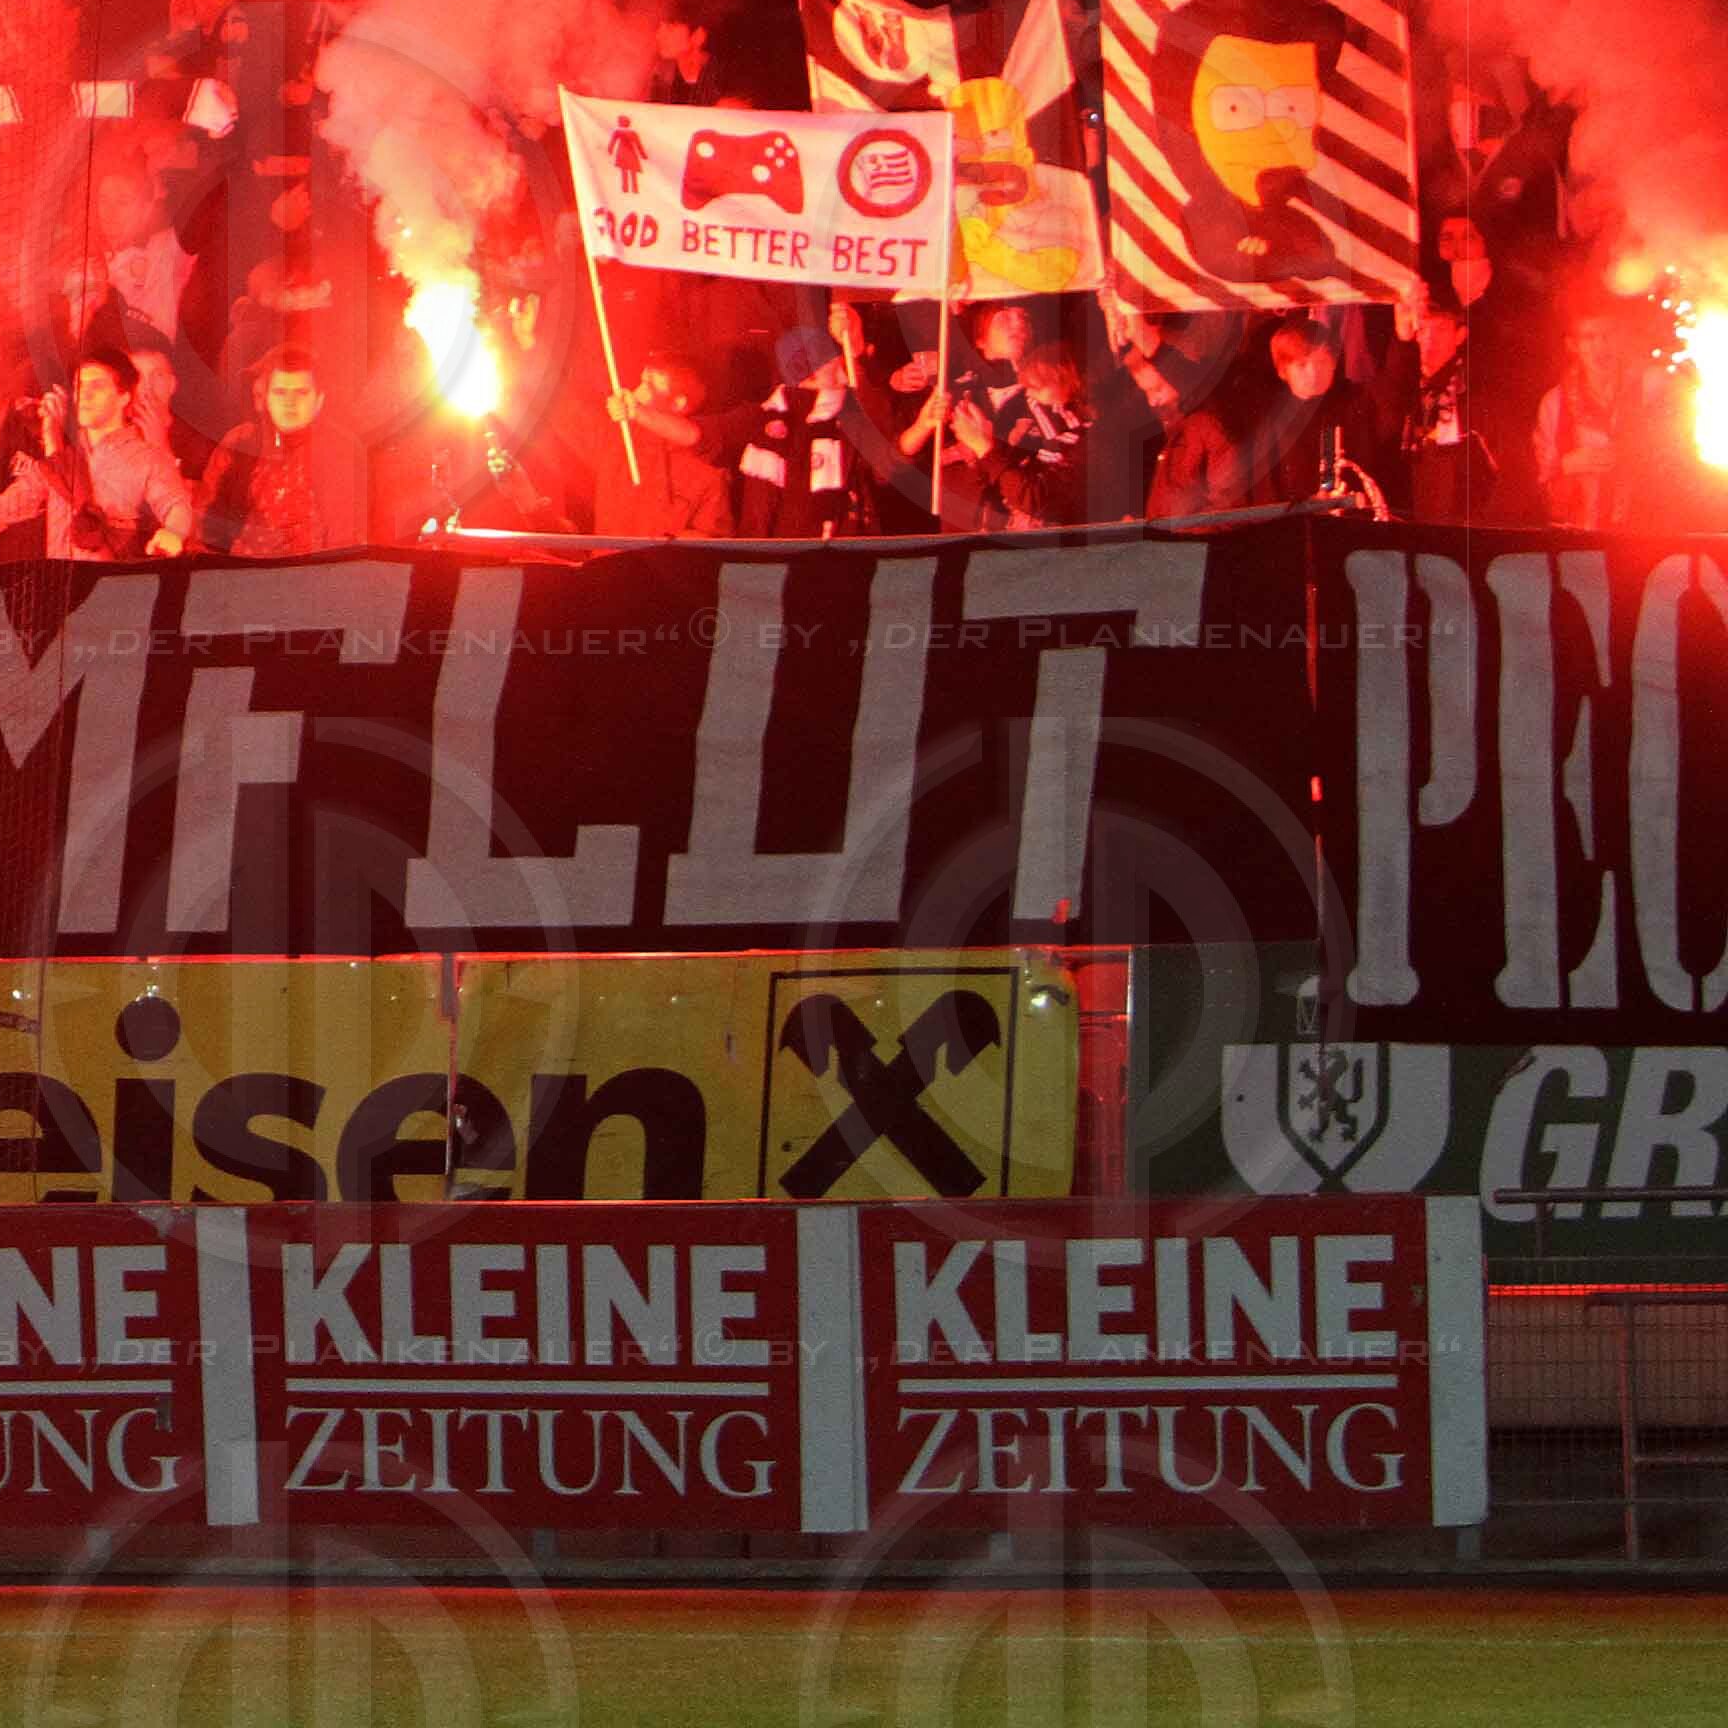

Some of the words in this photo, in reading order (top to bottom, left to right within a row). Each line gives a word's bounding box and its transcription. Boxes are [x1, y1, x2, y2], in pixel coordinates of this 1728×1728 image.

[682, 219, 810, 270] BETTER
[832, 235, 928, 277] BEST
[282, 1243, 770, 1366] KLEINE
[893, 1234, 1399, 1364] KLEINE
[283, 1406, 777, 1497] ZEITUNG
[895, 1402, 1407, 1497] ZEITUNG
